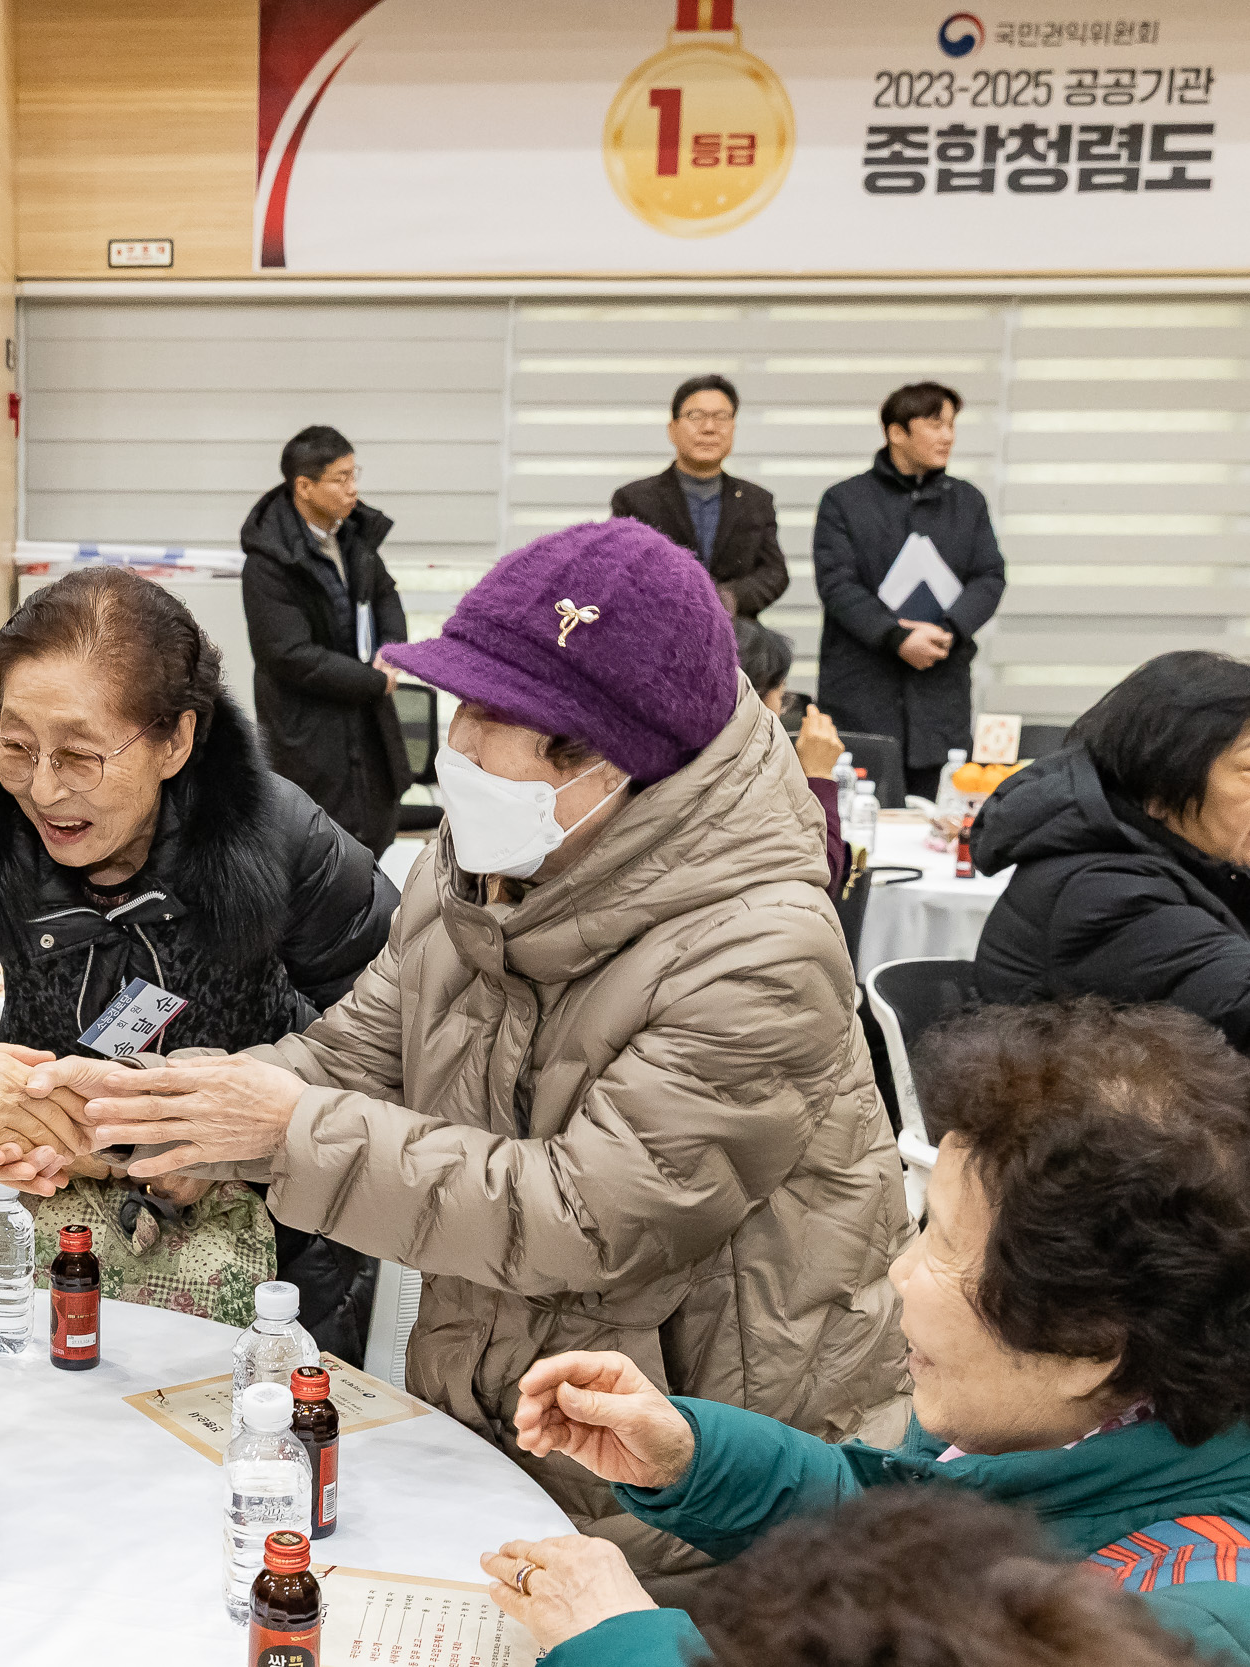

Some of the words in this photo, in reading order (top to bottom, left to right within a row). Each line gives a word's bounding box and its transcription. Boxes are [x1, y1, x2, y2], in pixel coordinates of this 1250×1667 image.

[996, 20, 1161, 47] 국민권익위원회
[874, 70, 1053, 108] 2023-2025
[1065, 67, 1215, 106] 공공기관
[864, 123, 1215, 194] 종합청렴도
